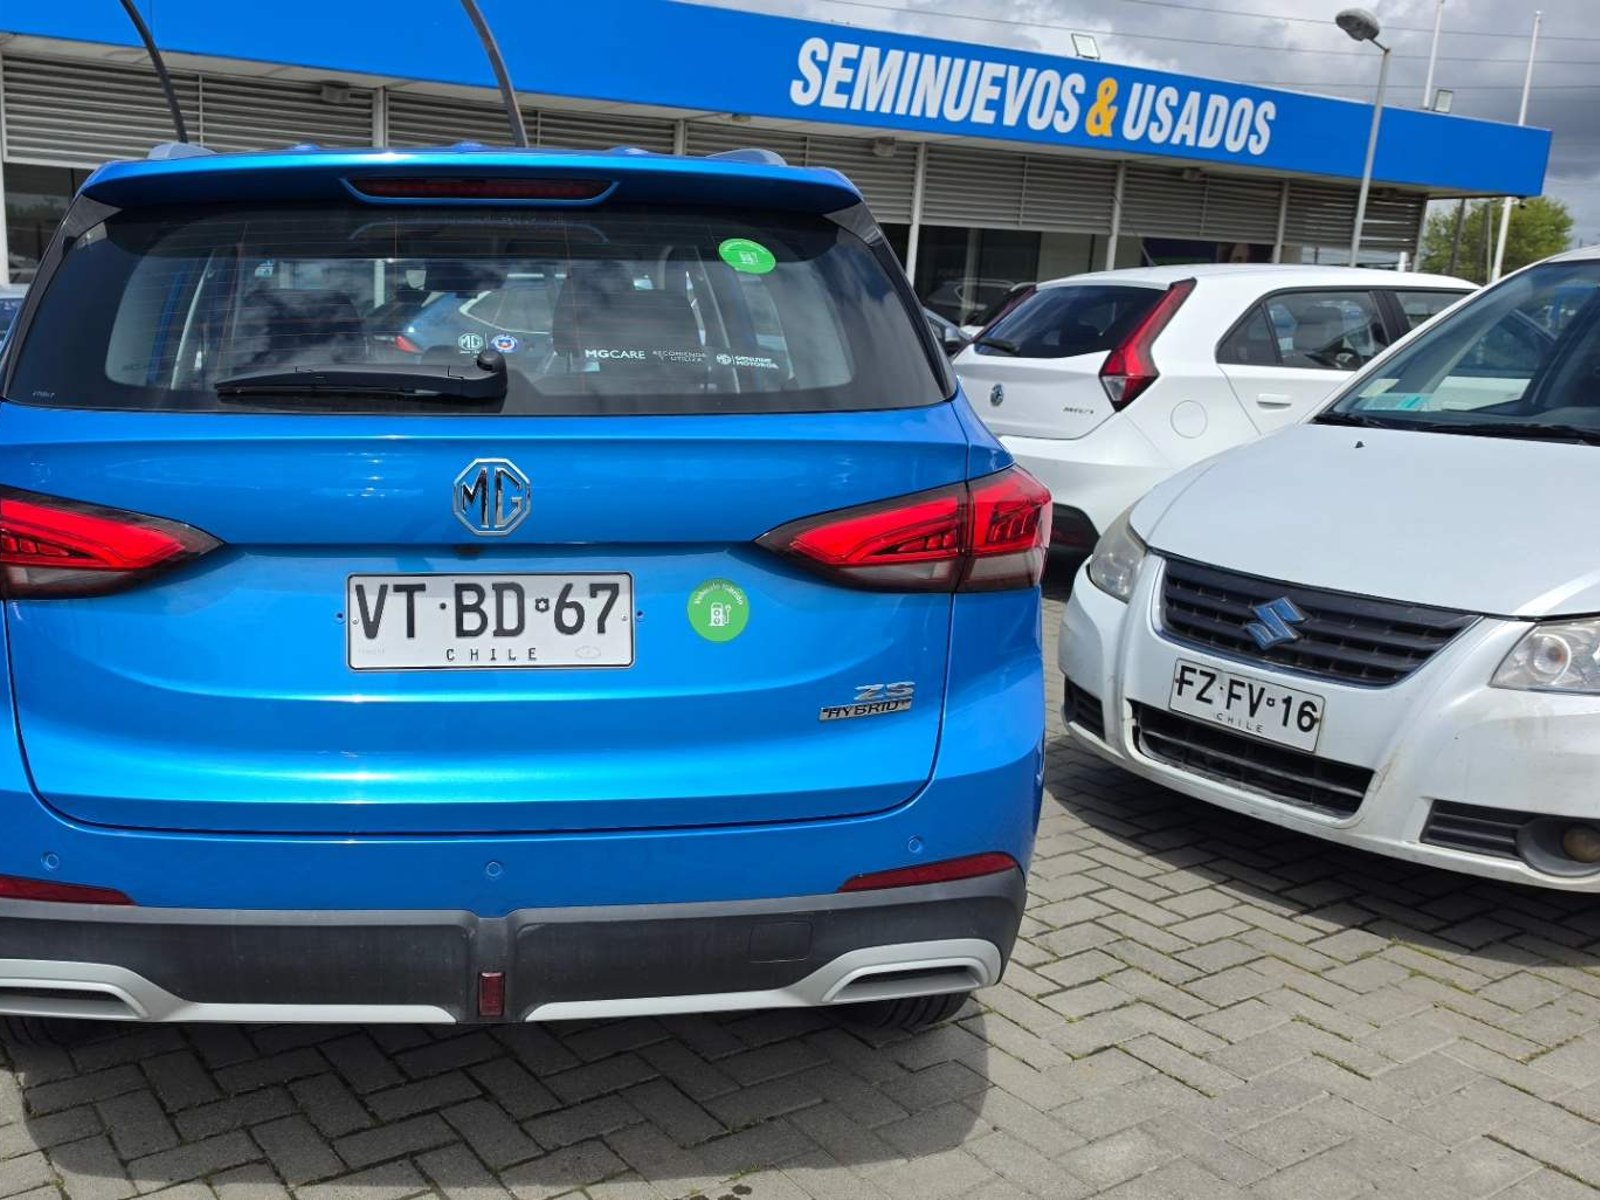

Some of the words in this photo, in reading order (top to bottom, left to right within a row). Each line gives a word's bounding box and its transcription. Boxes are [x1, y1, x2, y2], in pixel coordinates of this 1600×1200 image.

[789, 37, 1086, 134] SEMINUEVOS
[1085, 76, 1118, 138] &
[1122, 82, 1277, 156] USADOS
[460, 465, 523, 530] MG
[445, 646, 538, 662] CHILE
[853, 680, 916, 701] ZS
[822, 699, 900, 719] HYBRID
[1216, 711, 1264, 733] CHILE
